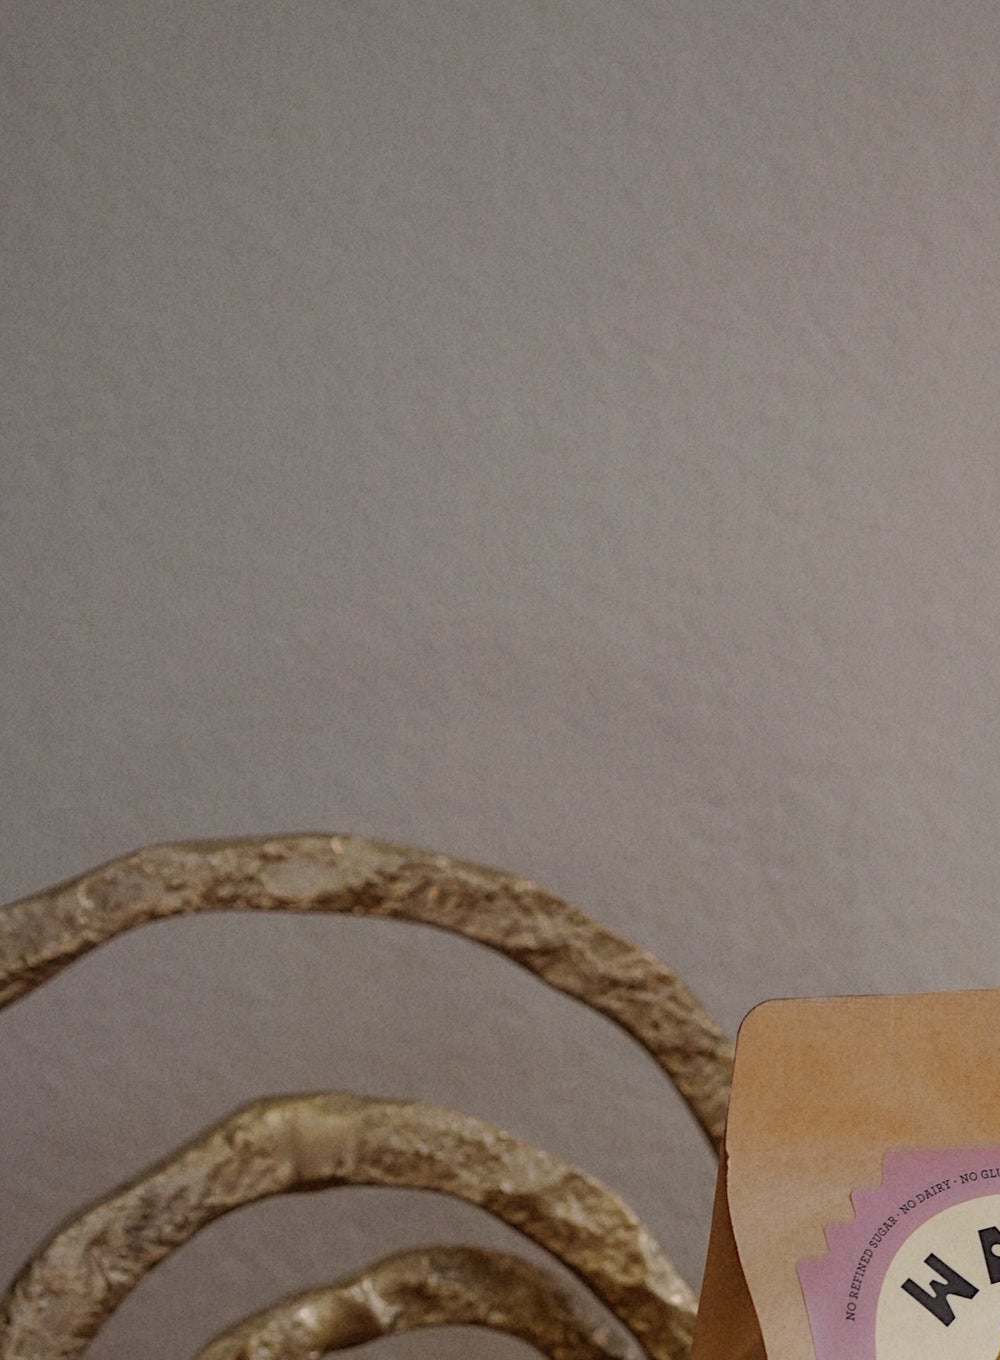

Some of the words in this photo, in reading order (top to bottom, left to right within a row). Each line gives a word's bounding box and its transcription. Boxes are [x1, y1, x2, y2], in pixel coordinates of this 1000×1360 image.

[959, 1171, 978, 1184] NO
[915, 1179, 951, 1204] DAIRY
[899, 1199, 917, 1215] NO
[868, 1214, 898, 1248] SUGAR
[849, 1248, 874, 1300] REFINED
[846, 1301, 857, 1321] NO
